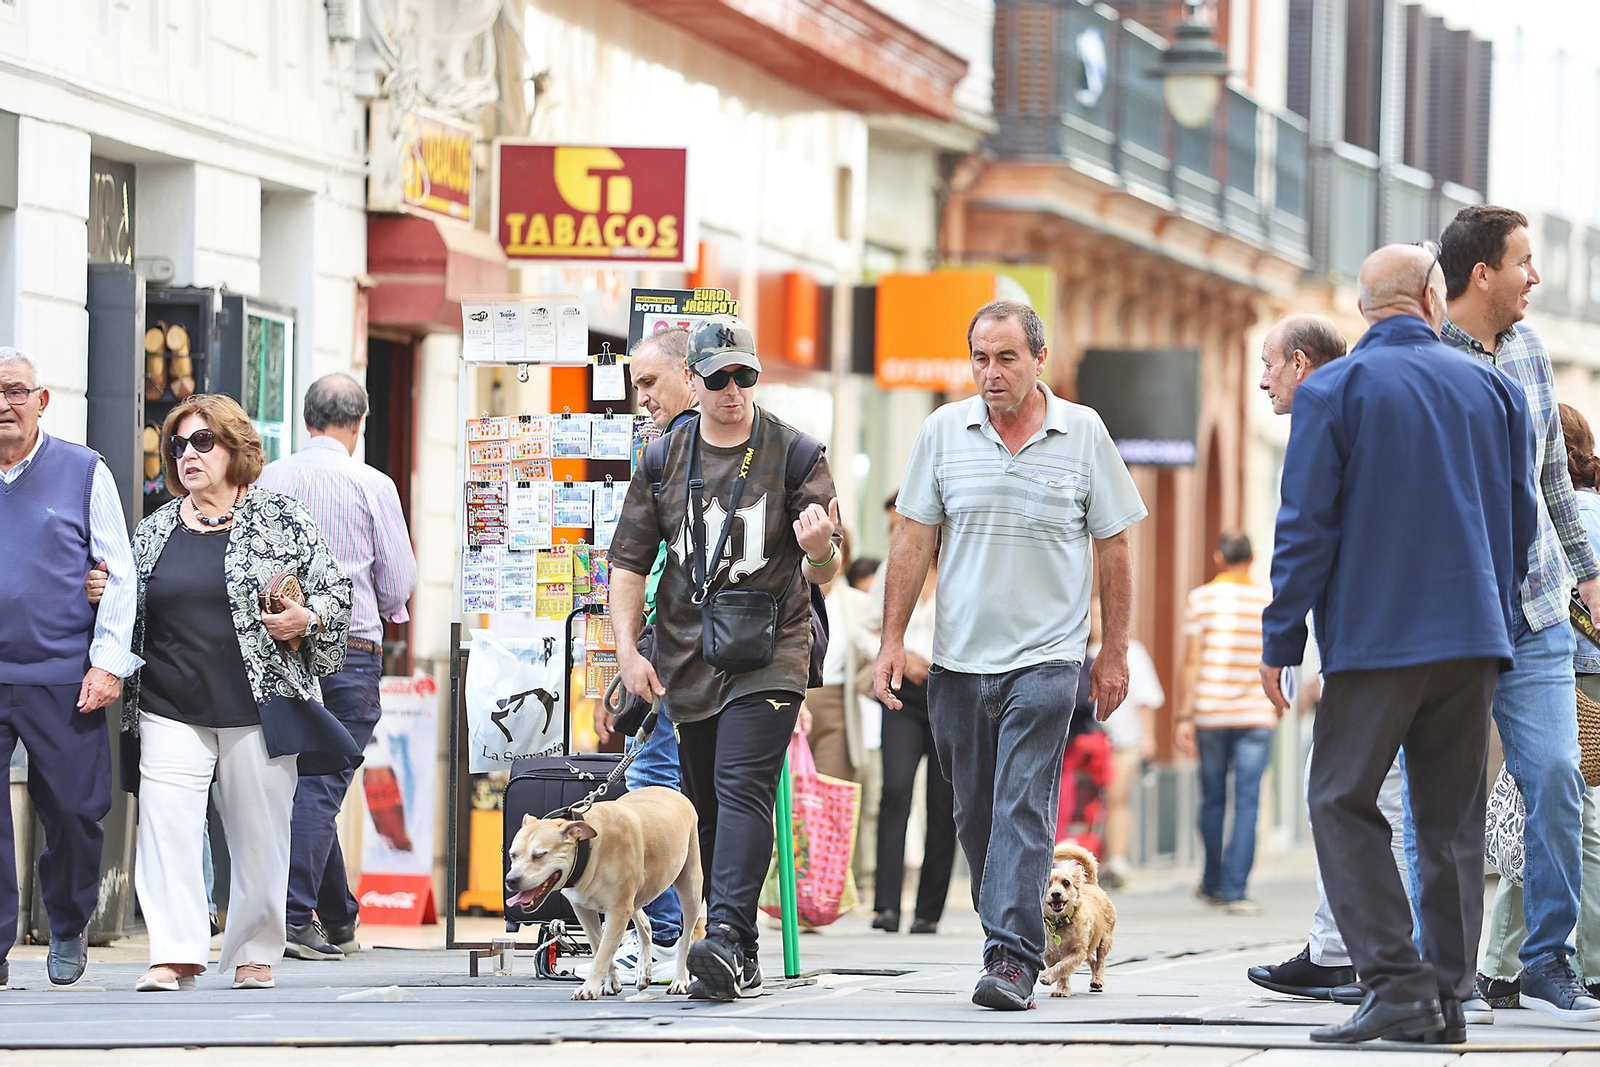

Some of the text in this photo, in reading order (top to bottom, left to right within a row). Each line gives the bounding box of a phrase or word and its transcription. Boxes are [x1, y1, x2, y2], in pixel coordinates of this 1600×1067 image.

[505, 212, 679, 248] TABACOS
[694, 288, 728, 301] EURO
[635, 303, 678, 313] BOTE DE
[682, 299, 738, 314] JACKPOT
[716, 328, 736, 348] NY
[738, 447, 755, 479] XTRM
[482, 744, 499, 761] La
